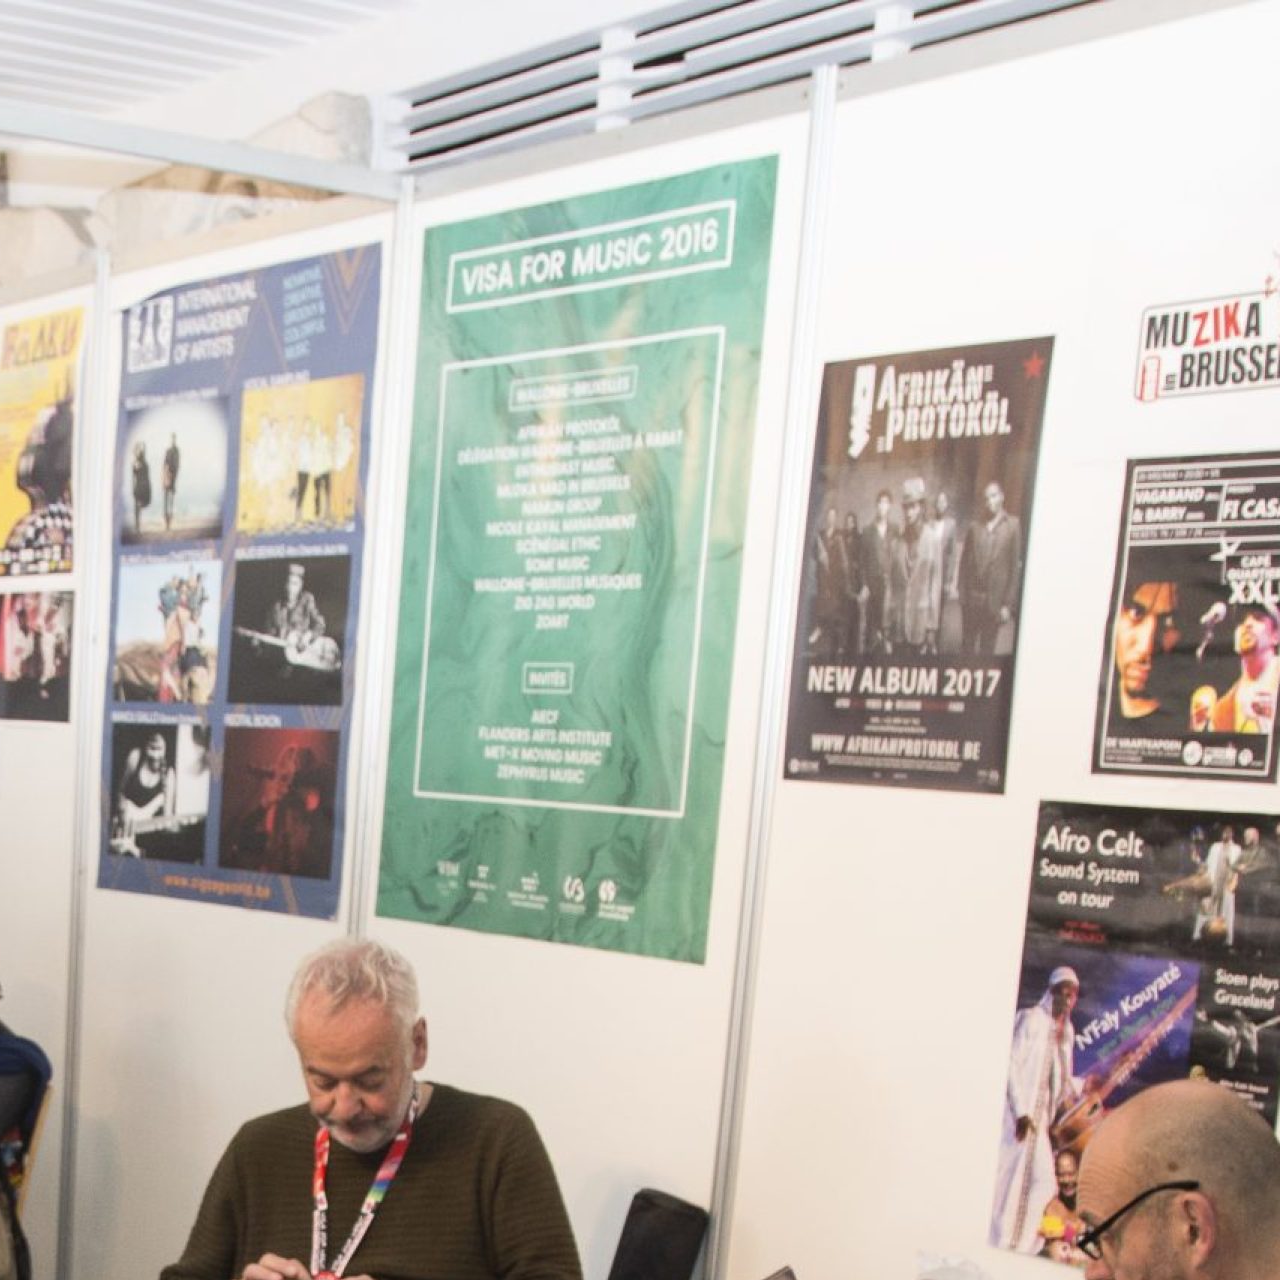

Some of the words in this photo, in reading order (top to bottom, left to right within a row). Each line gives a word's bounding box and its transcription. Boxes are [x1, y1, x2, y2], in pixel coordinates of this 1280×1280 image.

[461, 259, 513, 295] VISA
[520, 249, 566, 285] FOR
[572, 234, 652, 276] MUSIC
[659, 217, 719, 261] 2016
[1145, 301, 1261, 349] MUZIKA
[1179, 342, 1280, 388] BRUSSE
[886, 390, 1011, 453] PROTOKÖL
[807, 666, 856, 693] NEW
[859, 667, 938, 695] ALBUM
[942, 669, 1001, 697] 2017
[1042, 825, 1090, 854] Afro
[1097, 828, 1144, 858] Celt
[1040, 857, 1085, 880] Sound
[1087, 861, 1140, 886] System
[1057, 891, 1077, 905] on
[1081, 892, 1114, 908] tour
[1120, 962, 1182, 1016] Kouyaté
[1215, 968, 1247, 986] Sioen
[1249, 973, 1280, 993] plays
[1214, 989, 1275, 1011] Graceland
